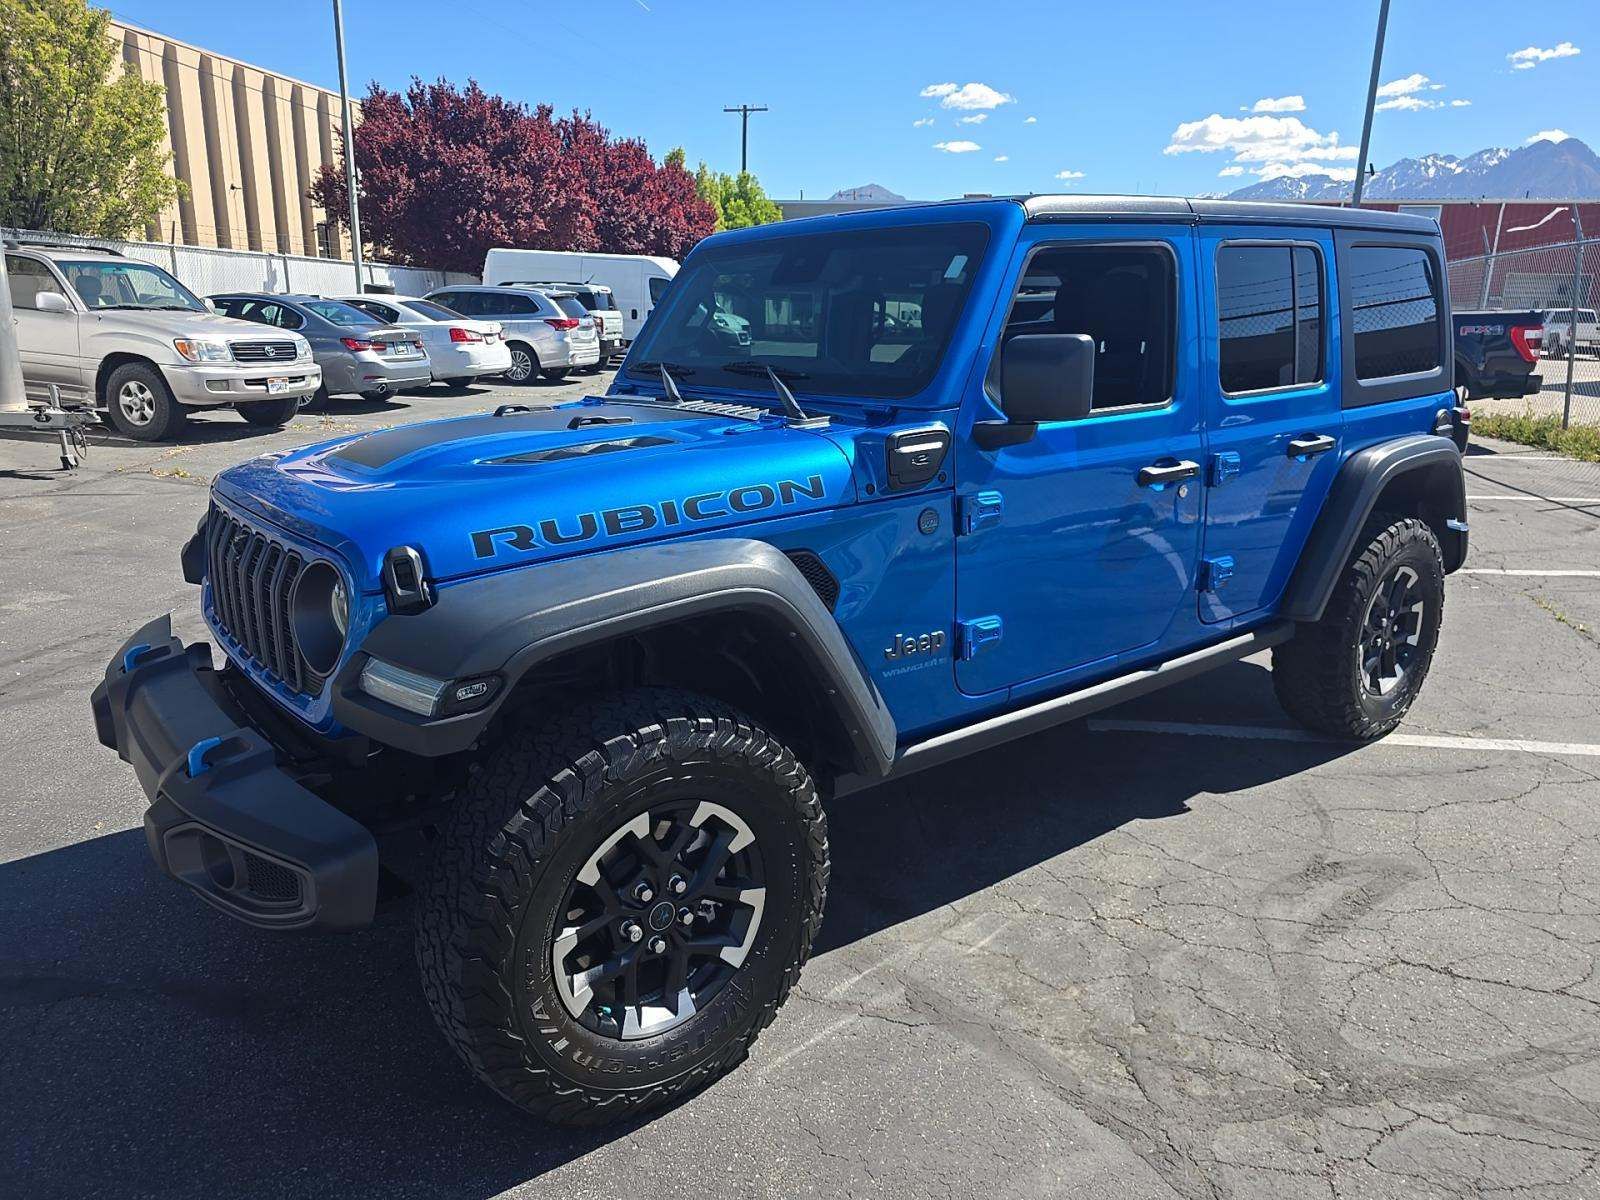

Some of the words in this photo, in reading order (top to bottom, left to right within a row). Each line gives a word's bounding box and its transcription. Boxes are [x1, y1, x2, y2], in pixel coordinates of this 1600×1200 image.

[469, 474, 826, 560] RUBICON
[884, 630, 945, 661] Jeep
[882, 659, 937, 678] WRANGLER
